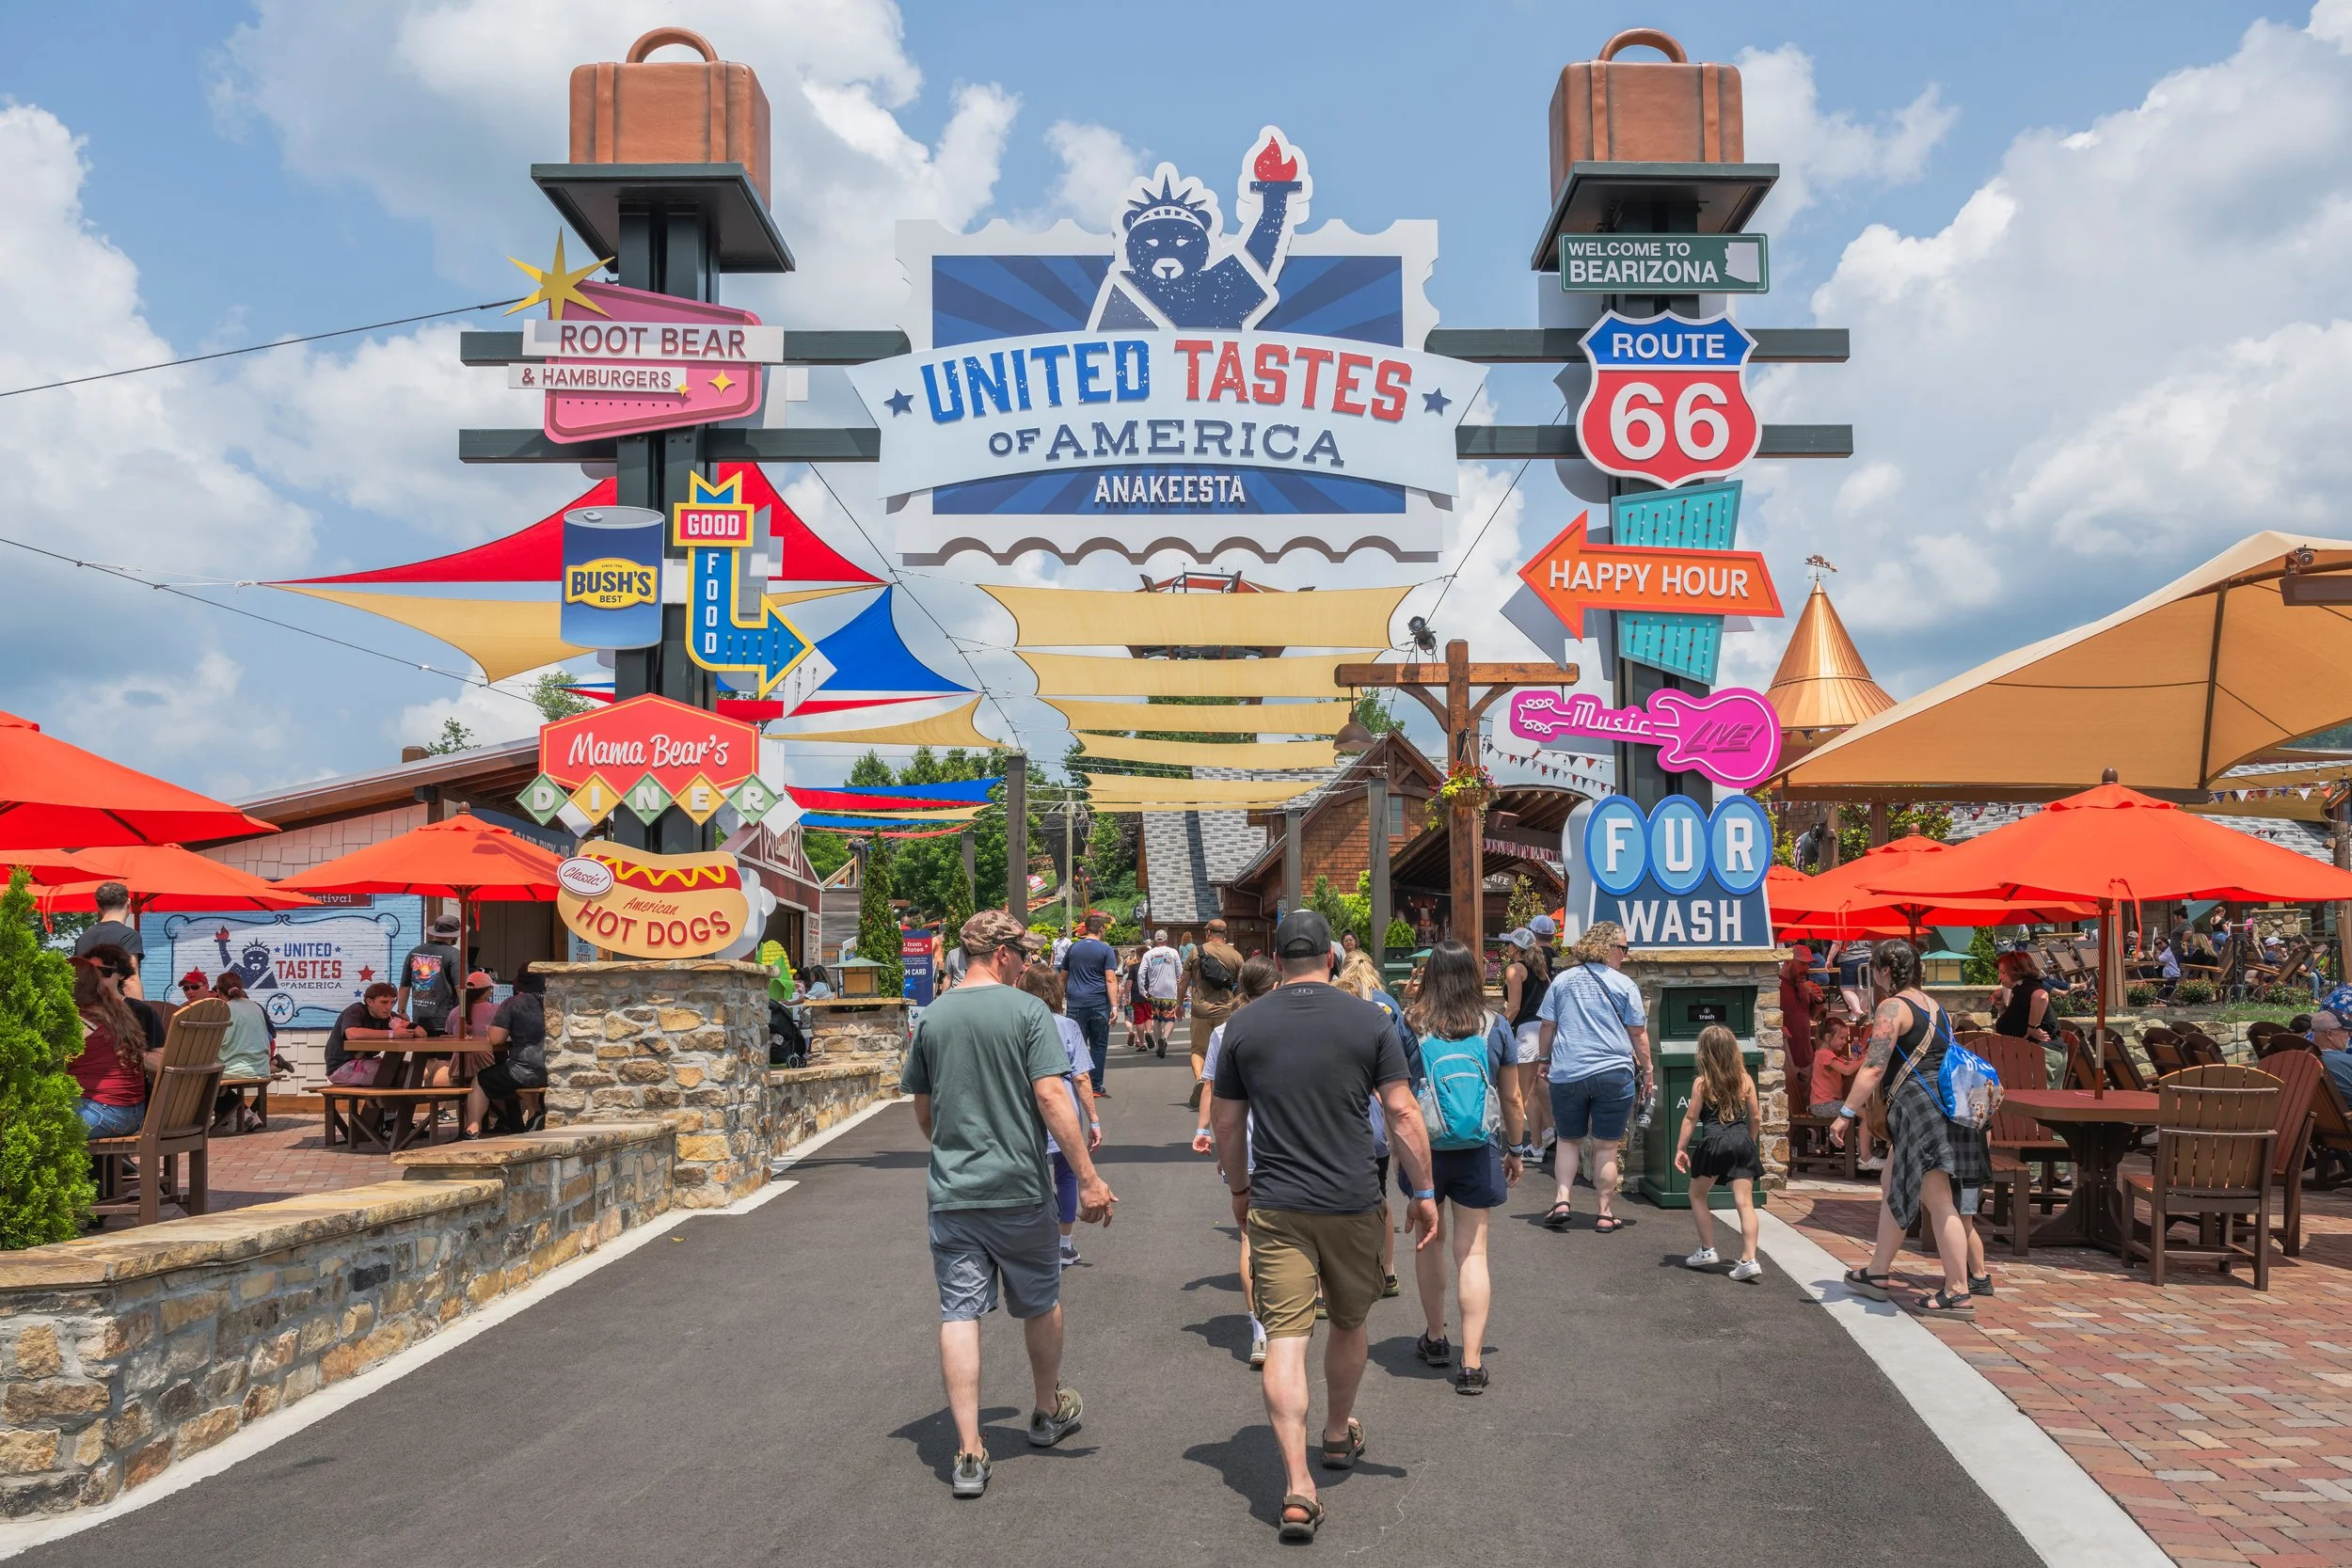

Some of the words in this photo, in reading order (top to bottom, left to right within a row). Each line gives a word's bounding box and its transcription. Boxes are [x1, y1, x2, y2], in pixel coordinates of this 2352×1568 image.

[1568, 242, 1661, 257] WELCOME
[1666, 242, 1691, 257] TO
[1569, 260, 1720, 284] BEARIZONA
[560, 325, 648, 355] ROOT
[660, 327, 747, 358] BEAR
[1613, 333, 1726, 359] ROUTE
[521, 367, 535, 385] &
[542, 368, 672, 389] HAMBURGERS
[920, 339, 1151, 424] UNITED
[1174, 339, 1413, 423] TASTES
[1610, 382, 1730, 461] 66
[988, 427, 1041, 456] OF
[1045, 419, 1345, 467] AMERICA
[1093, 475, 1247, 504] ANAKEESTA
[687, 514, 739, 536] GOOD
[571, 570, 652, 597] BUSH'S
[1549, 560, 1652, 594] HAPPY
[1661, 564, 1749, 597] HOUR
[706, 553, 720, 655] FOOD
[1572, 700, 1652, 736] Music
[1684, 720, 1765, 752] LIVE!
[568, 732, 647, 767] Mama
[650, 735, 730, 768] Bear's
[533, 786, 765, 812] DINER
[1604, 817, 1755, 873] FUR
[563, 866, 610, 888] Classic!
[623, 896, 680, 916] American
[575, 899, 638, 942] HOT
[646, 911, 731, 946] DOGS
[1617, 899, 1742, 942] WASH
[283, 942, 332, 958] UNITED
[276, 959, 342, 979] TASTES
[290, 981, 342, 990] AMERICA
